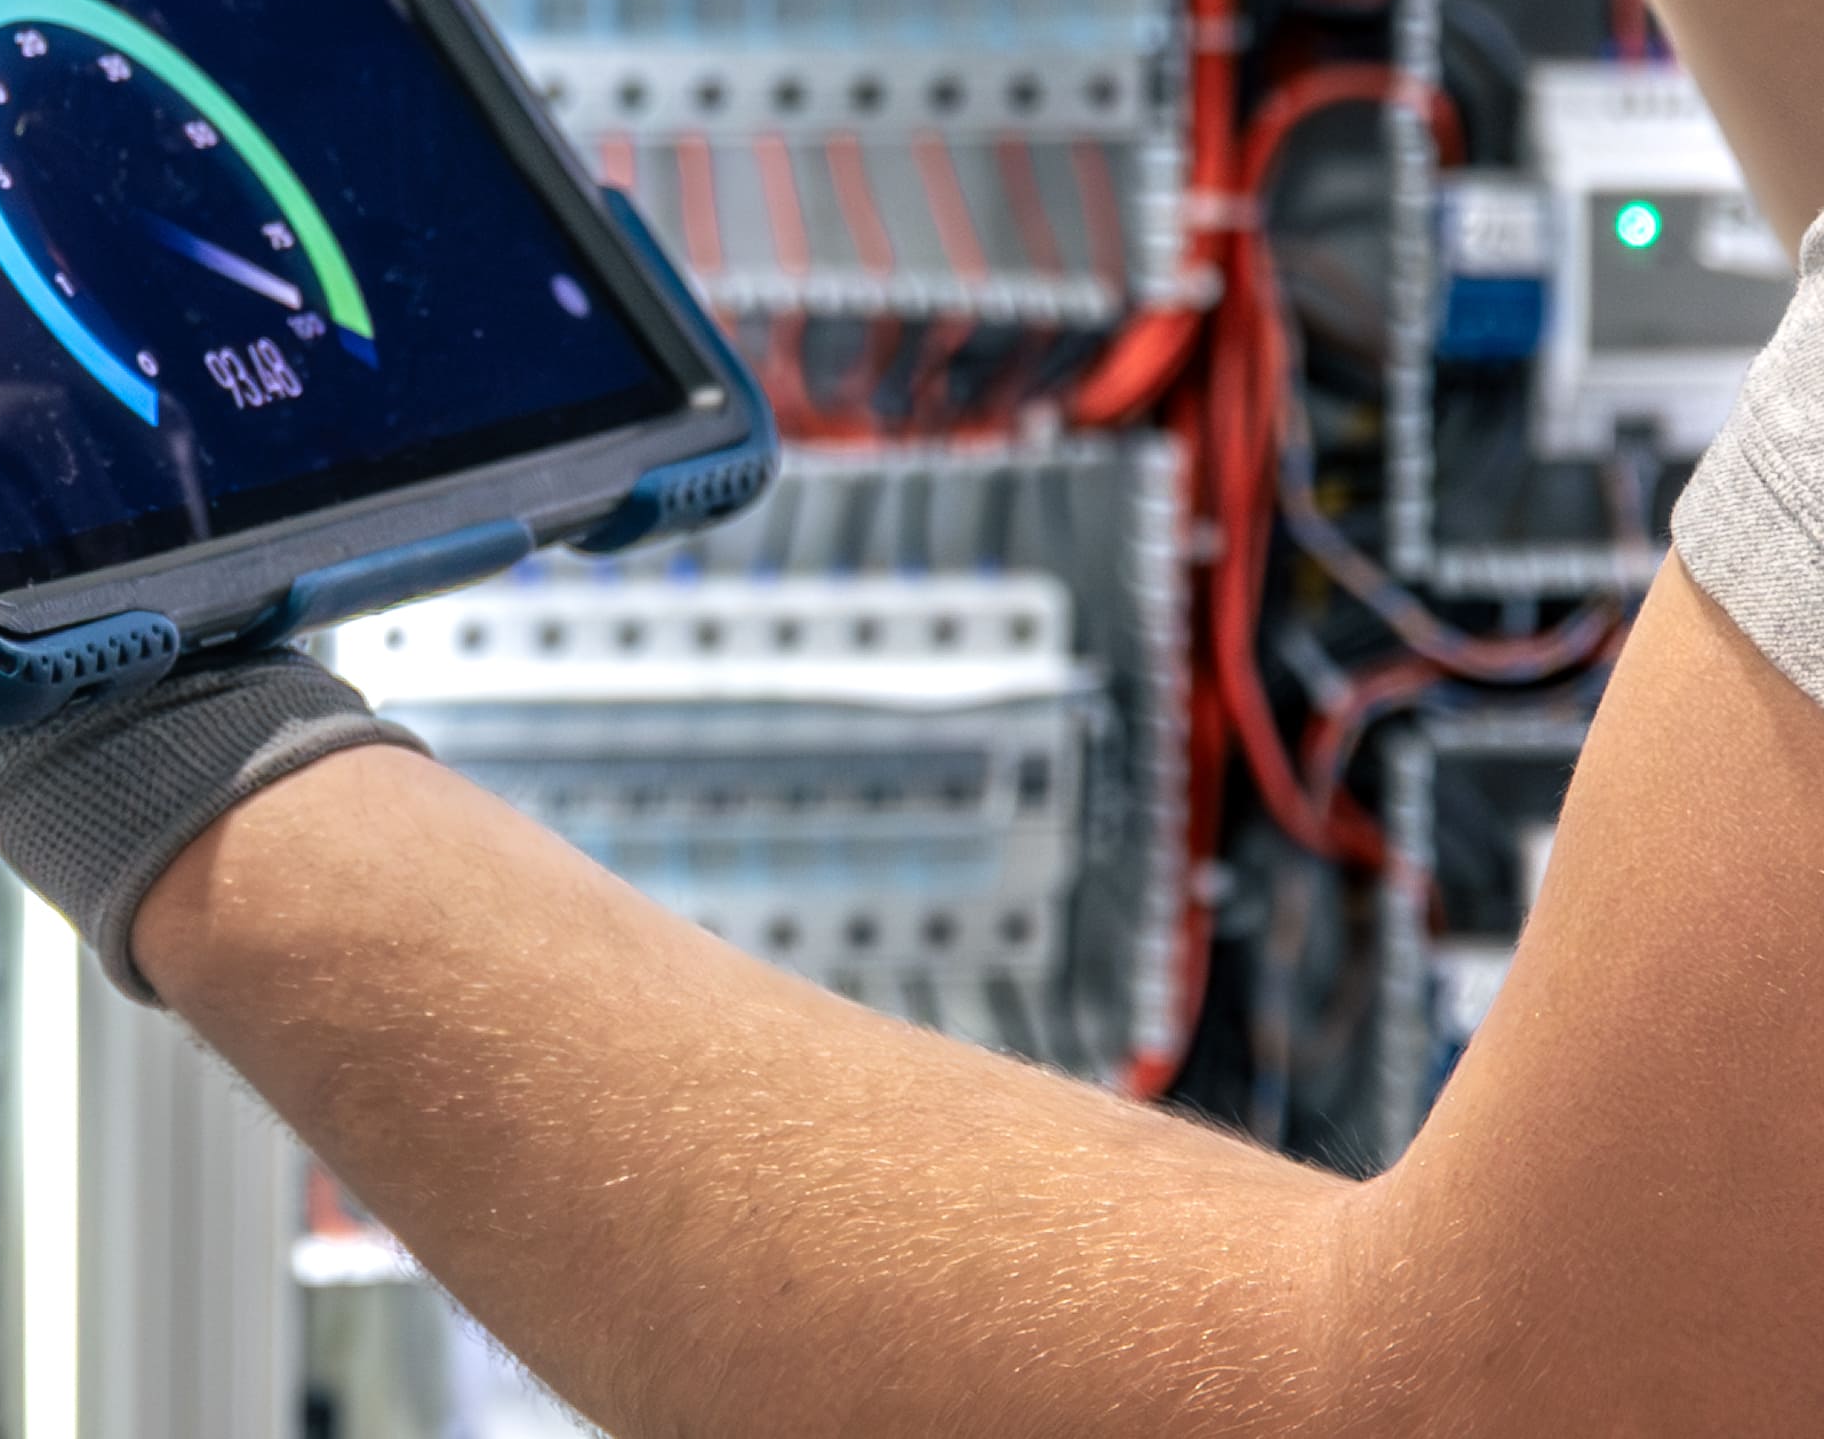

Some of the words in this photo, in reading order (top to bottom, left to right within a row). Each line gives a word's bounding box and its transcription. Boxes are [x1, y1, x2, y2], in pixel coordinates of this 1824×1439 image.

[14, 29, 48, 58] 20
[97, 53, 132, 83] 30
[184, 120, 219, 149] 50
[261, 220, 295, 250] 75
[54, 273, 75, 298] 1
[136, 351, 159, 377] 0
[204, 336, 302, 409] 93.48
